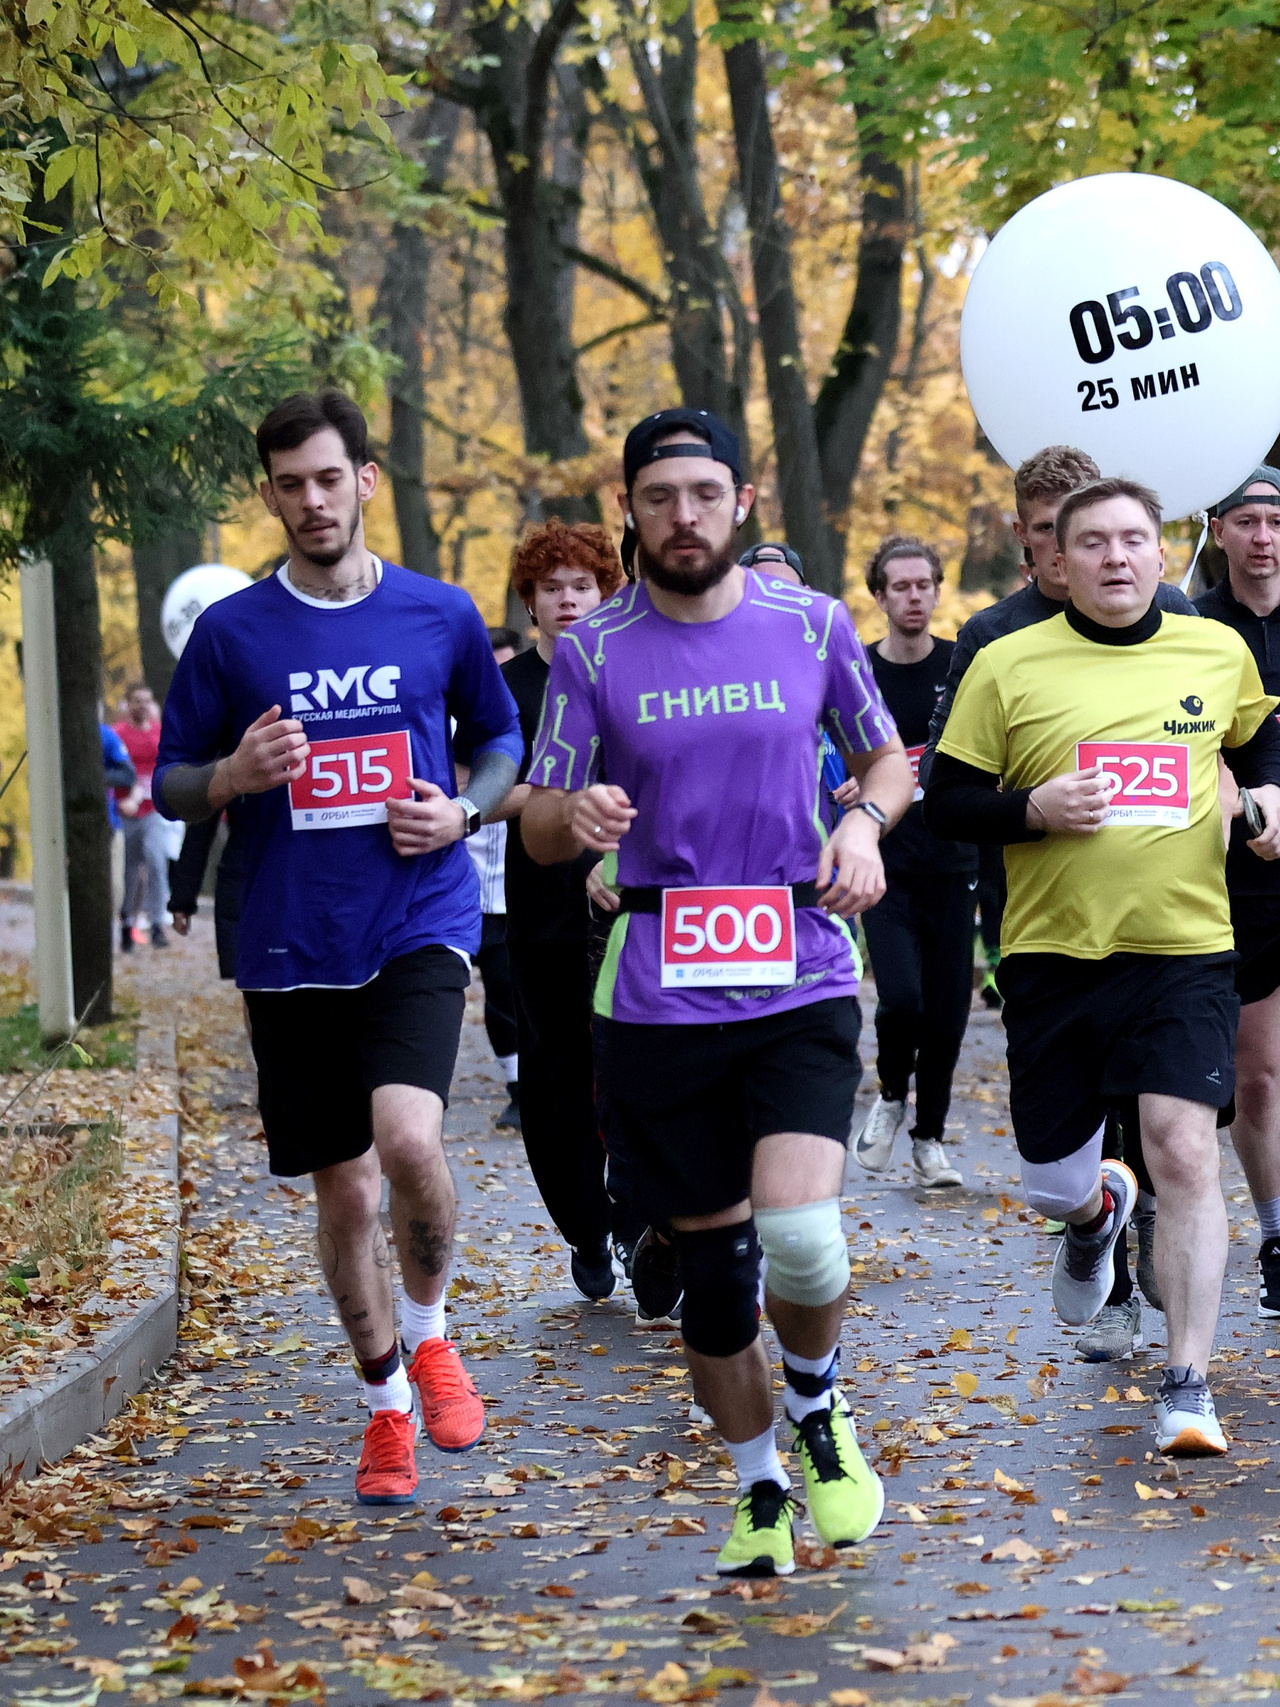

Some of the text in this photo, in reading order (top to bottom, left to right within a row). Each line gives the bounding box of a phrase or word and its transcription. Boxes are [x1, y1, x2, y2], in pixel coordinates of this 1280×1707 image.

[1069, 261, 1243, 365] 05:00
[1077, 378, 1120, 412] 25
[335, 704, 402, 720] МЕДИАГРУППА
[636, 679, 787, 725] ГНИВЦ
[311, 747, 393, 799] 515
[1095, 755, 1179, 798] 525
[671, 903, 783, 956] 500
